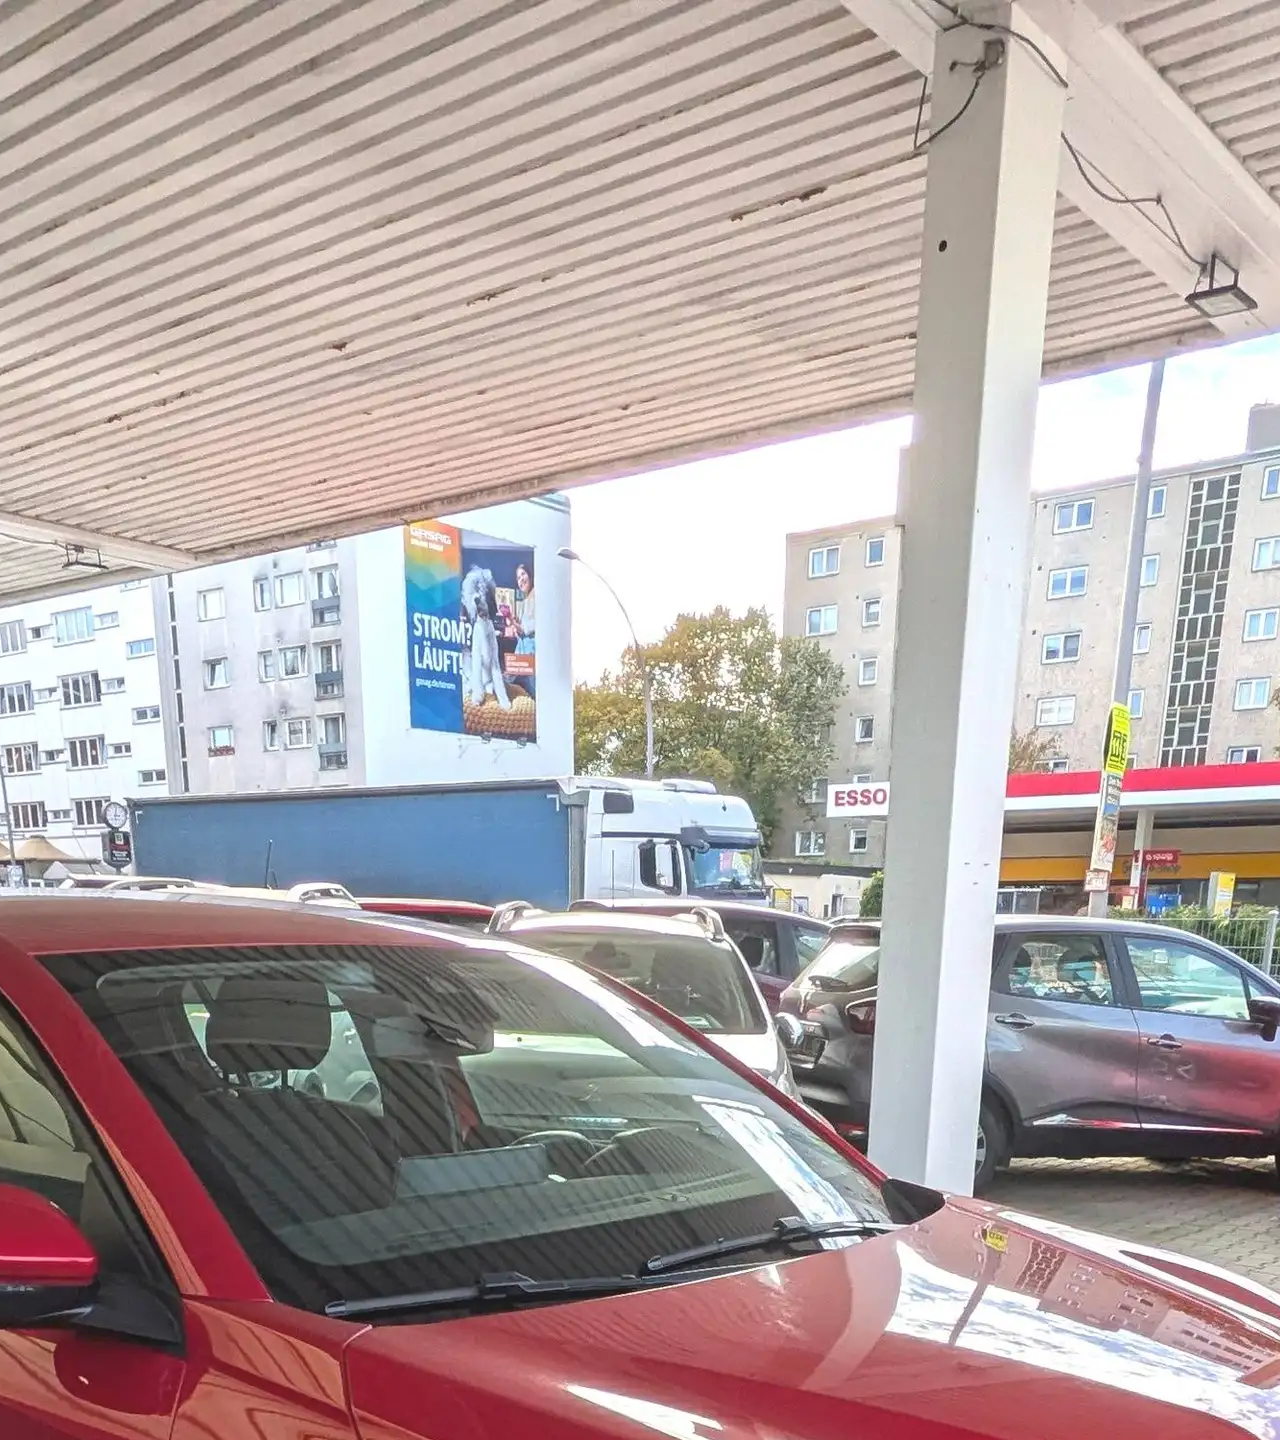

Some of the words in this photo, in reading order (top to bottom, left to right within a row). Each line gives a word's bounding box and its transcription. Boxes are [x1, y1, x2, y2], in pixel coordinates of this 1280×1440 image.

[413, 612, 473, 646] STROM?
[414, 641, 464, 676] LÄUFT!
[834, 788, 888, 807] ESSO
